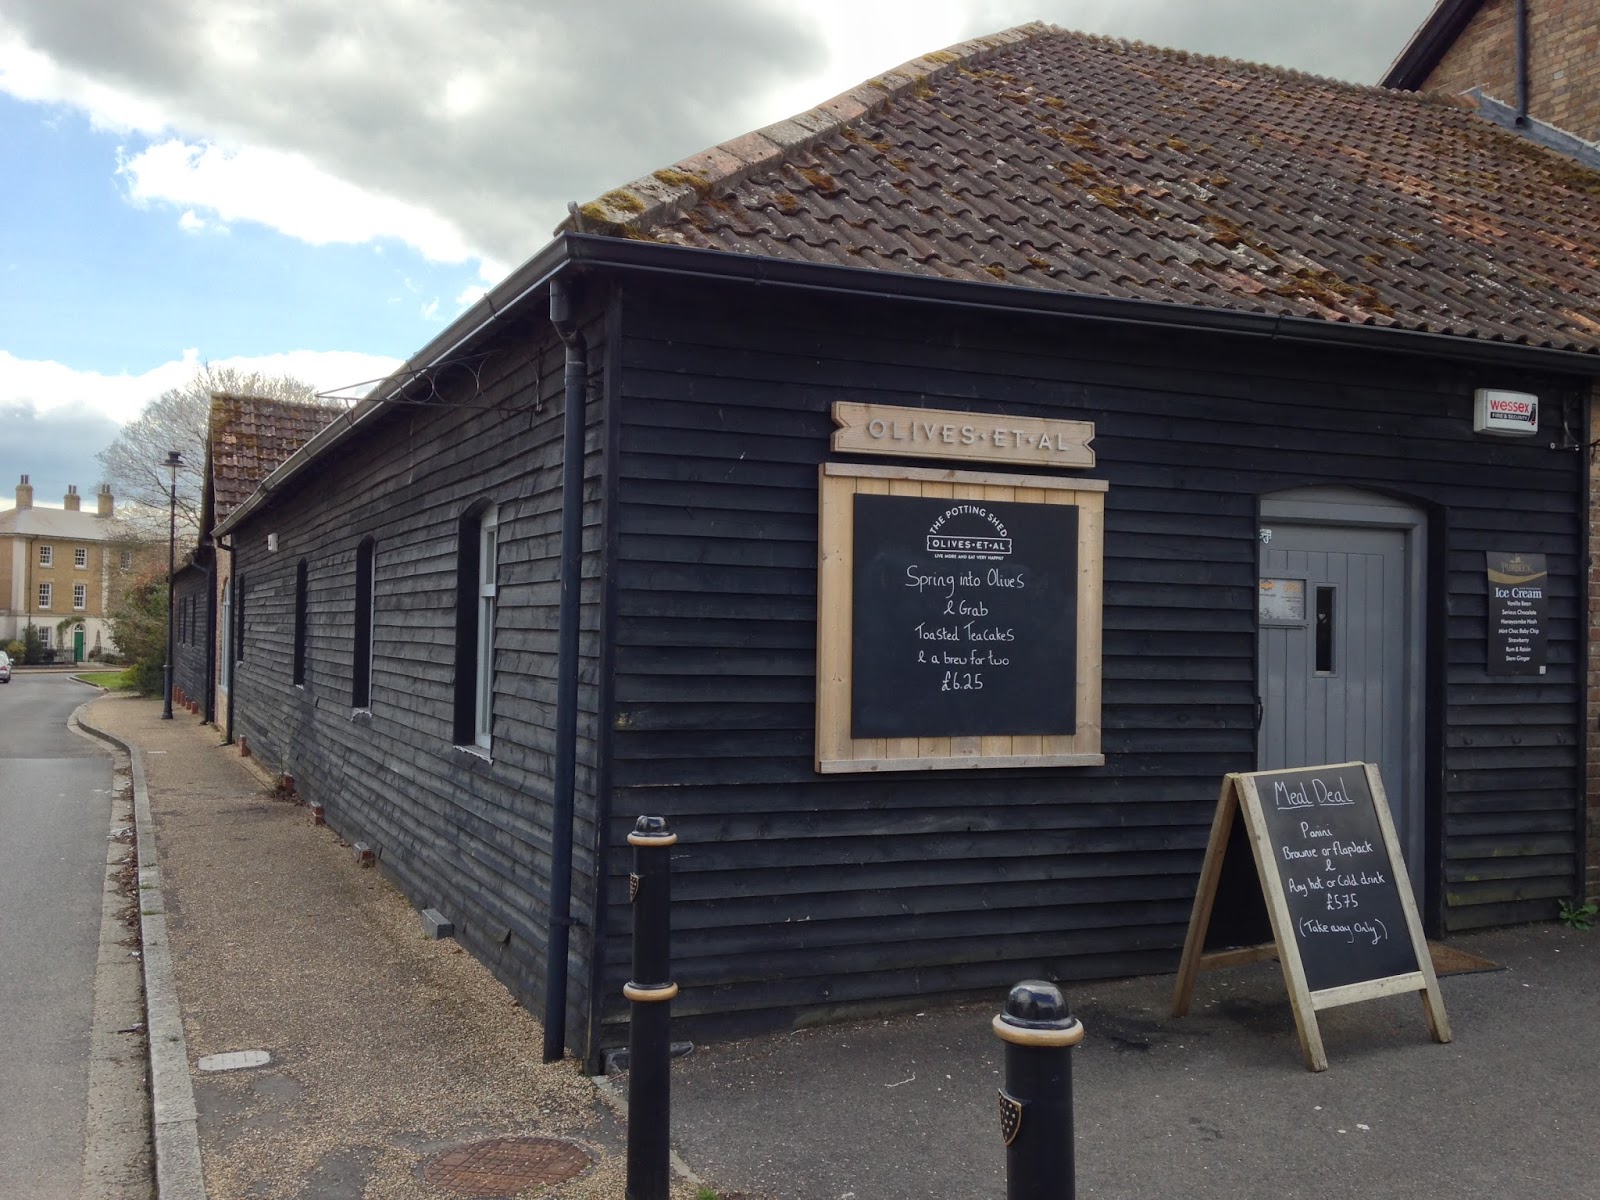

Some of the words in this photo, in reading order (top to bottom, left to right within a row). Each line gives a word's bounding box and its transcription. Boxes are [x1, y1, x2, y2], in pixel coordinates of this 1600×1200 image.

[1490, 400, 1530, 413] wessex
[929, 516, 946, 534] THE
[946, 505, 986, 519] POTTING
[988, 513, 1008, 537] SHED
[905, 565, 955, 598] Spring
[960, 570, 981, 587] into
[987, 568, 1025, 588] Olives
[1495, 587, 1509, 598] Ice
[1512, 587, 1542, 598] Cream
[959, 600, 988, 617] Grab
[914, 622, 960, 641] Toasted
[931, 655, 940, 663] a
[944, 651, 967, 664] brew
[970, 649, 985, 664] for
[988, 650, 1009, 665] two
[942, 670, 984, 692] £6.25
[1274, 780, 1314, 806] Meal
[1312, 777, 1354, 803] Deal
[1300, 822, 1333, 838] Panini
[1322, 848, 1331, 856] or
[1289, 878, 1308, 898] Any
[1308, 876, 1324, 890] hot
[1327, 880, 1336, 888] or
[1361, 871, 1385, 884] drink
[1330, 924, 1354, 944] away
